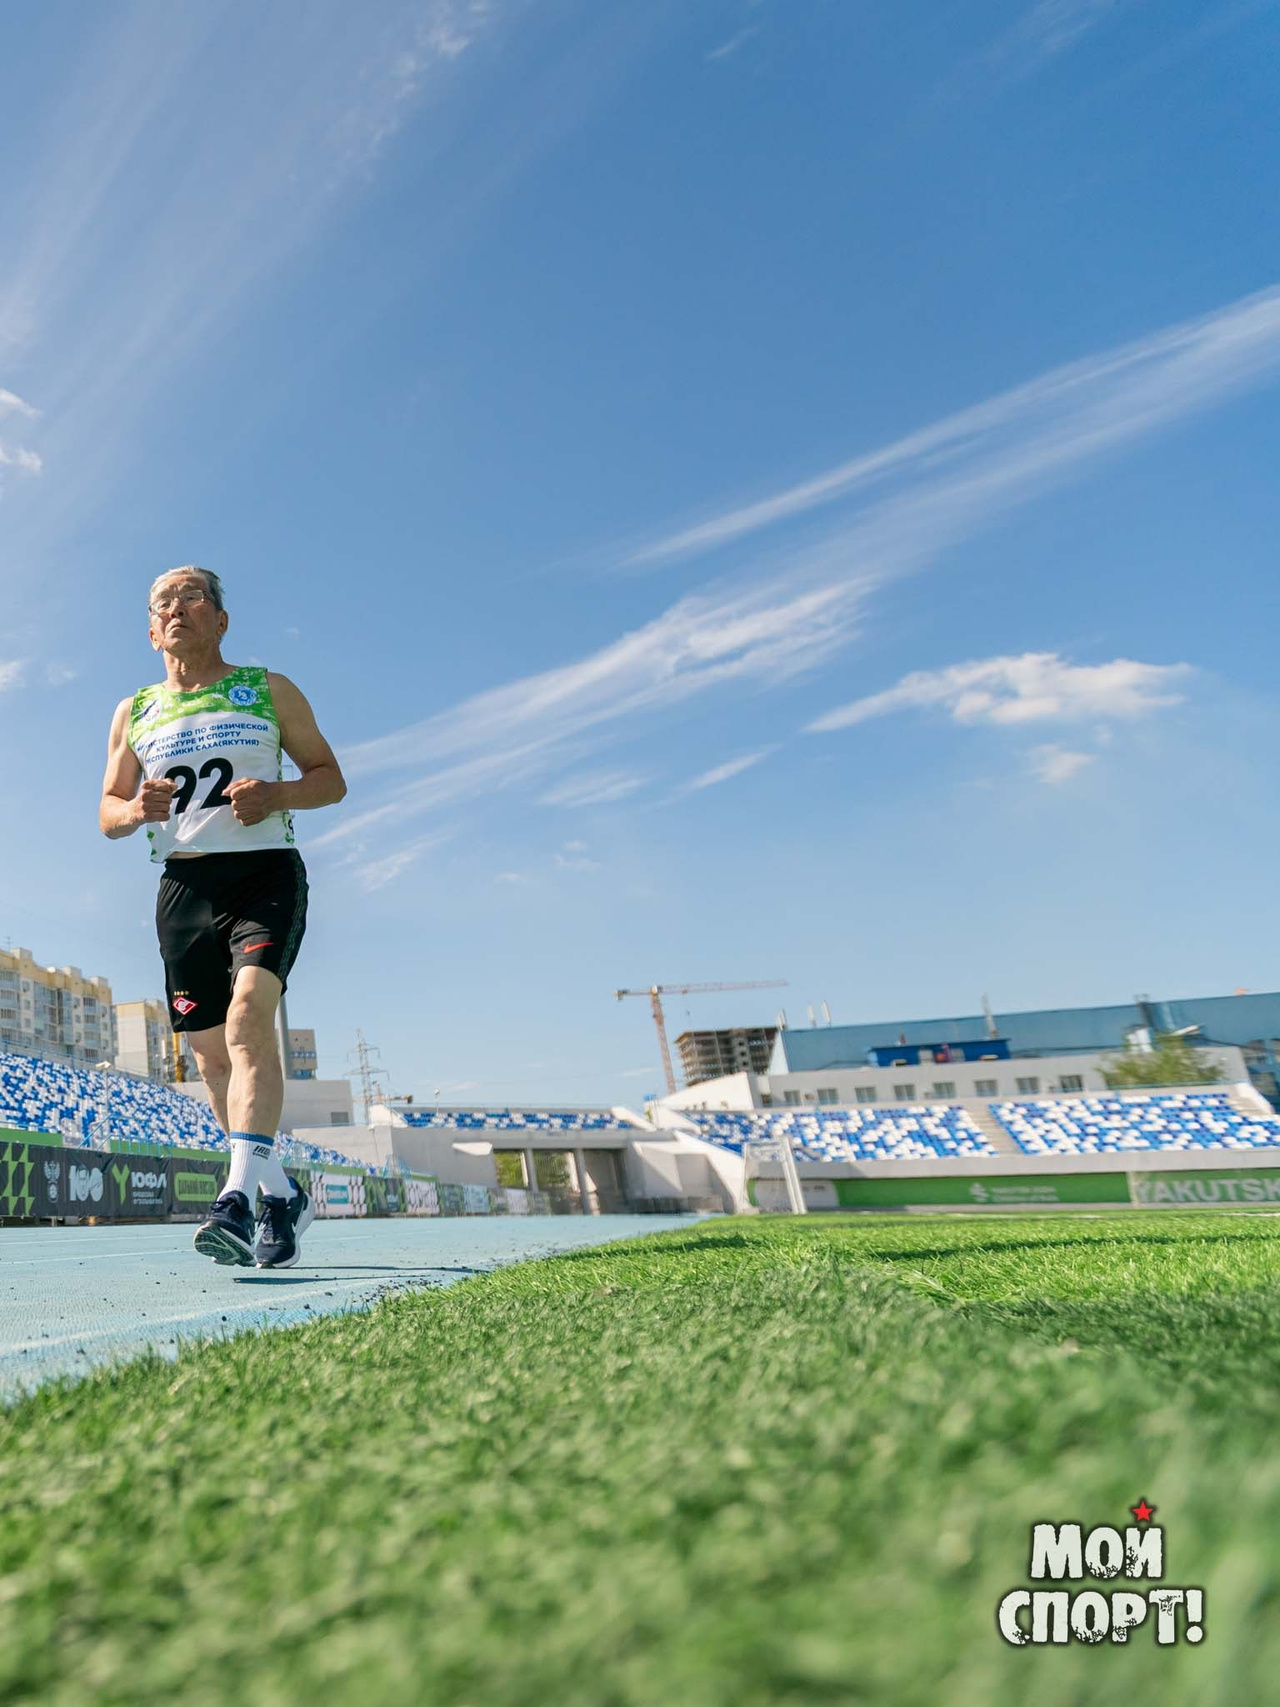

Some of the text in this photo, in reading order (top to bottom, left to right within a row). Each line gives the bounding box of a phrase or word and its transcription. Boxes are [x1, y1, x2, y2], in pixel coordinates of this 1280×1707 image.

[195, 727, 207, 735] ПО
[209, 723, 268, 732] ФИЗИЧЕСКОЙ
[156, 738, 196, 752] КУЛЬТУРЕ
[206, 731, 241, 740] СПОРТУ
[164, 757, 234, 815] 92
[131, 1172, 168, 1189] ЮФЛ
